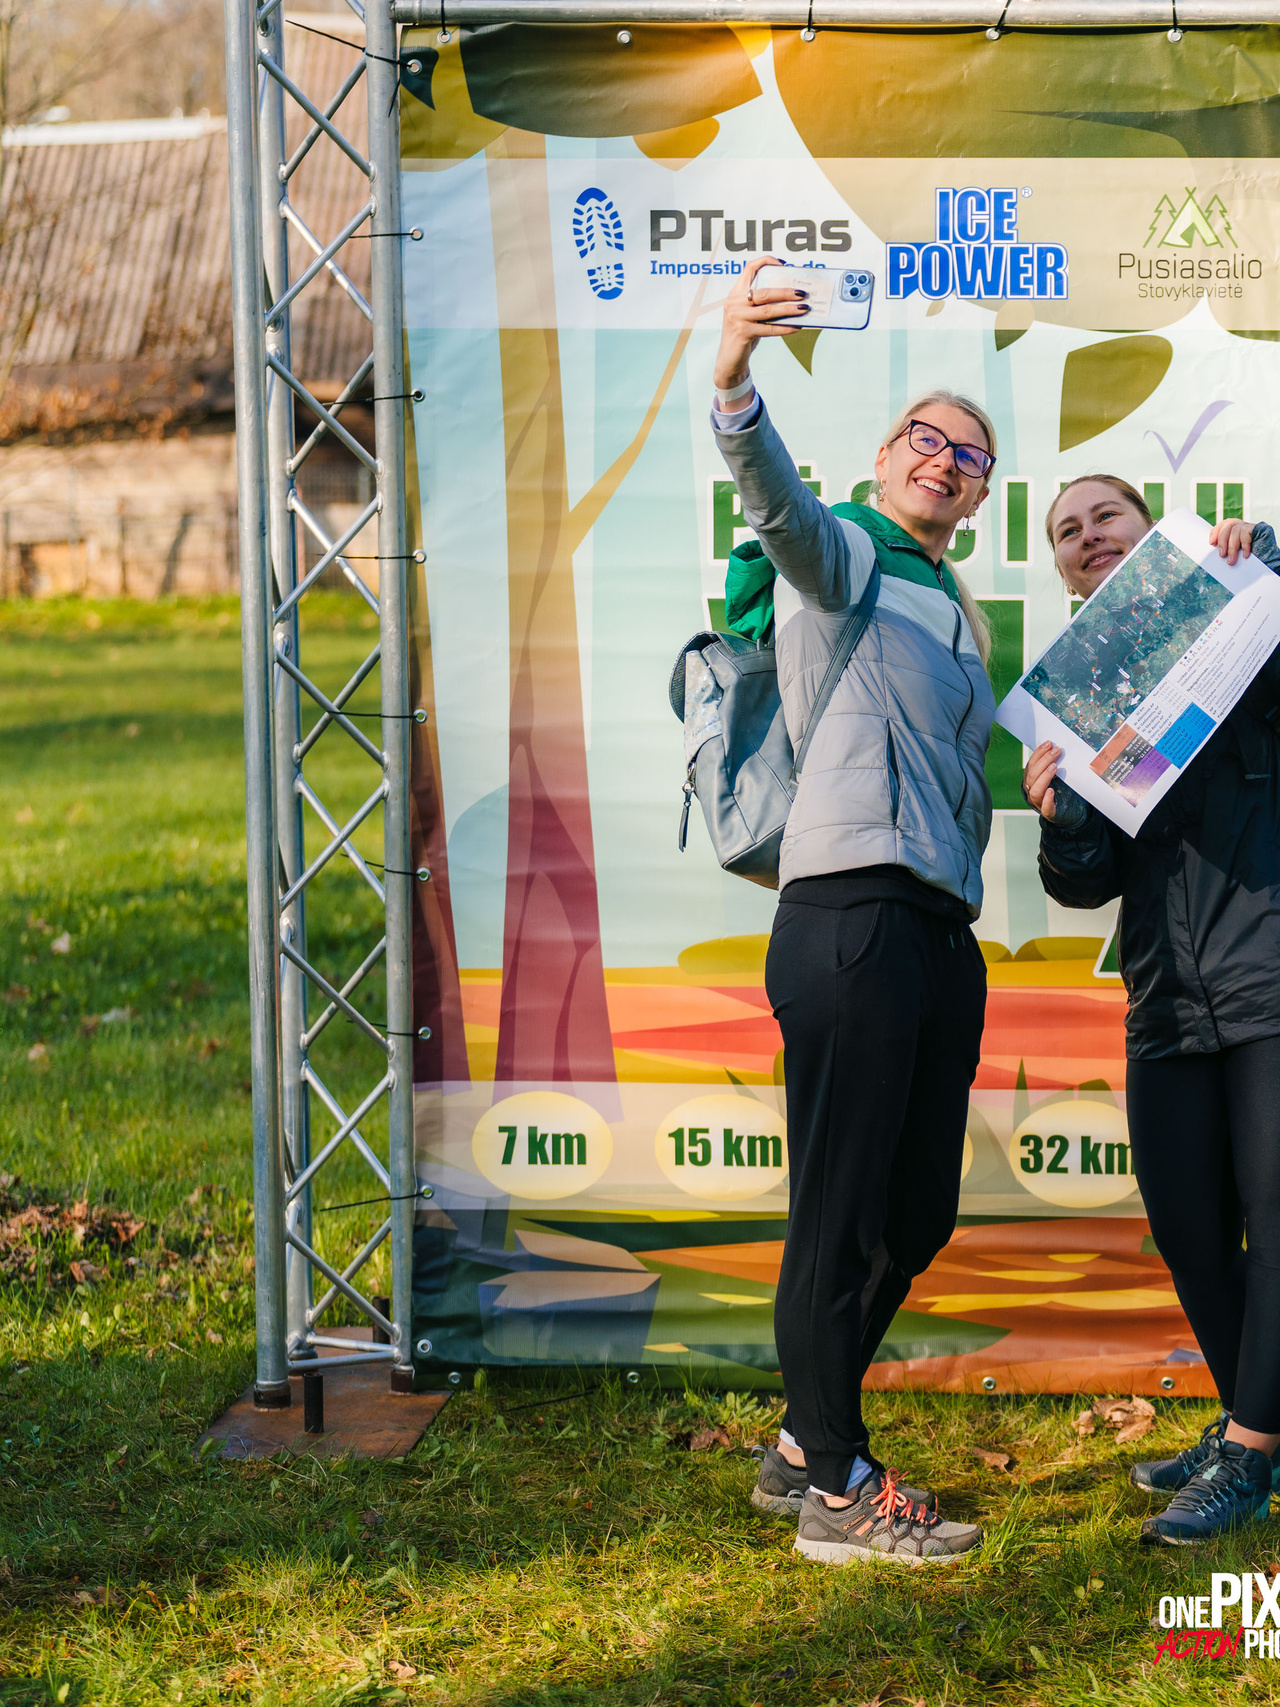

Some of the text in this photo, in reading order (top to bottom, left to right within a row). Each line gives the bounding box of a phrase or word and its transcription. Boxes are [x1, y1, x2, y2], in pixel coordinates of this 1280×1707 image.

[650, 209, 852, 252] PTuras
[935, 187, 1018, 243] ICE
[650, 260, 747, 278] Impossibl
[886, 243, 1069, 300] POWER
[1119, 253, 1262, 279] Pusiasalio
[1138, 283, 1243, 301] Stovyklavietė
[498, 1126, 586, 1165] 7 km
[668, 1127, 782, 1167] 15 km
[1020, 1134, 1135, 1175] 32 km
